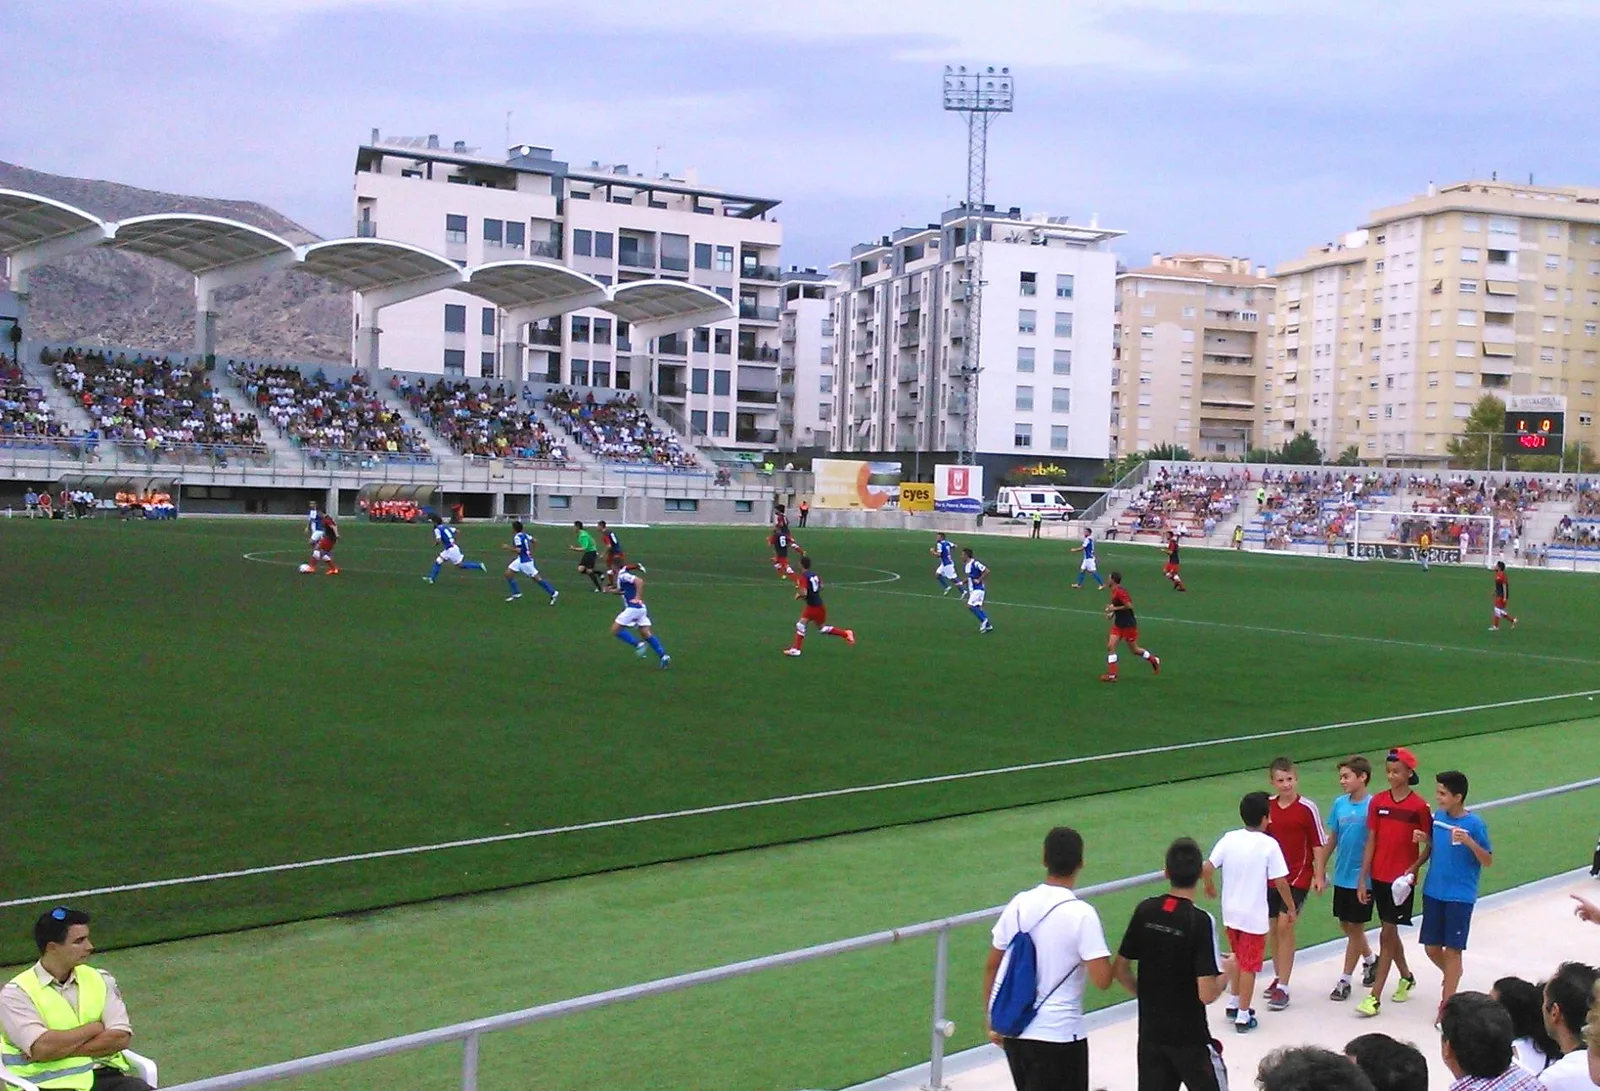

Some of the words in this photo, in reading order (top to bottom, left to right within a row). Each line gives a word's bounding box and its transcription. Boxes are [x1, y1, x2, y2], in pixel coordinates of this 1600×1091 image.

[1542, 419, 1550, 431] 0
[903, 489, 930, 502] cyes
[779, 535, 787, 547] 6
